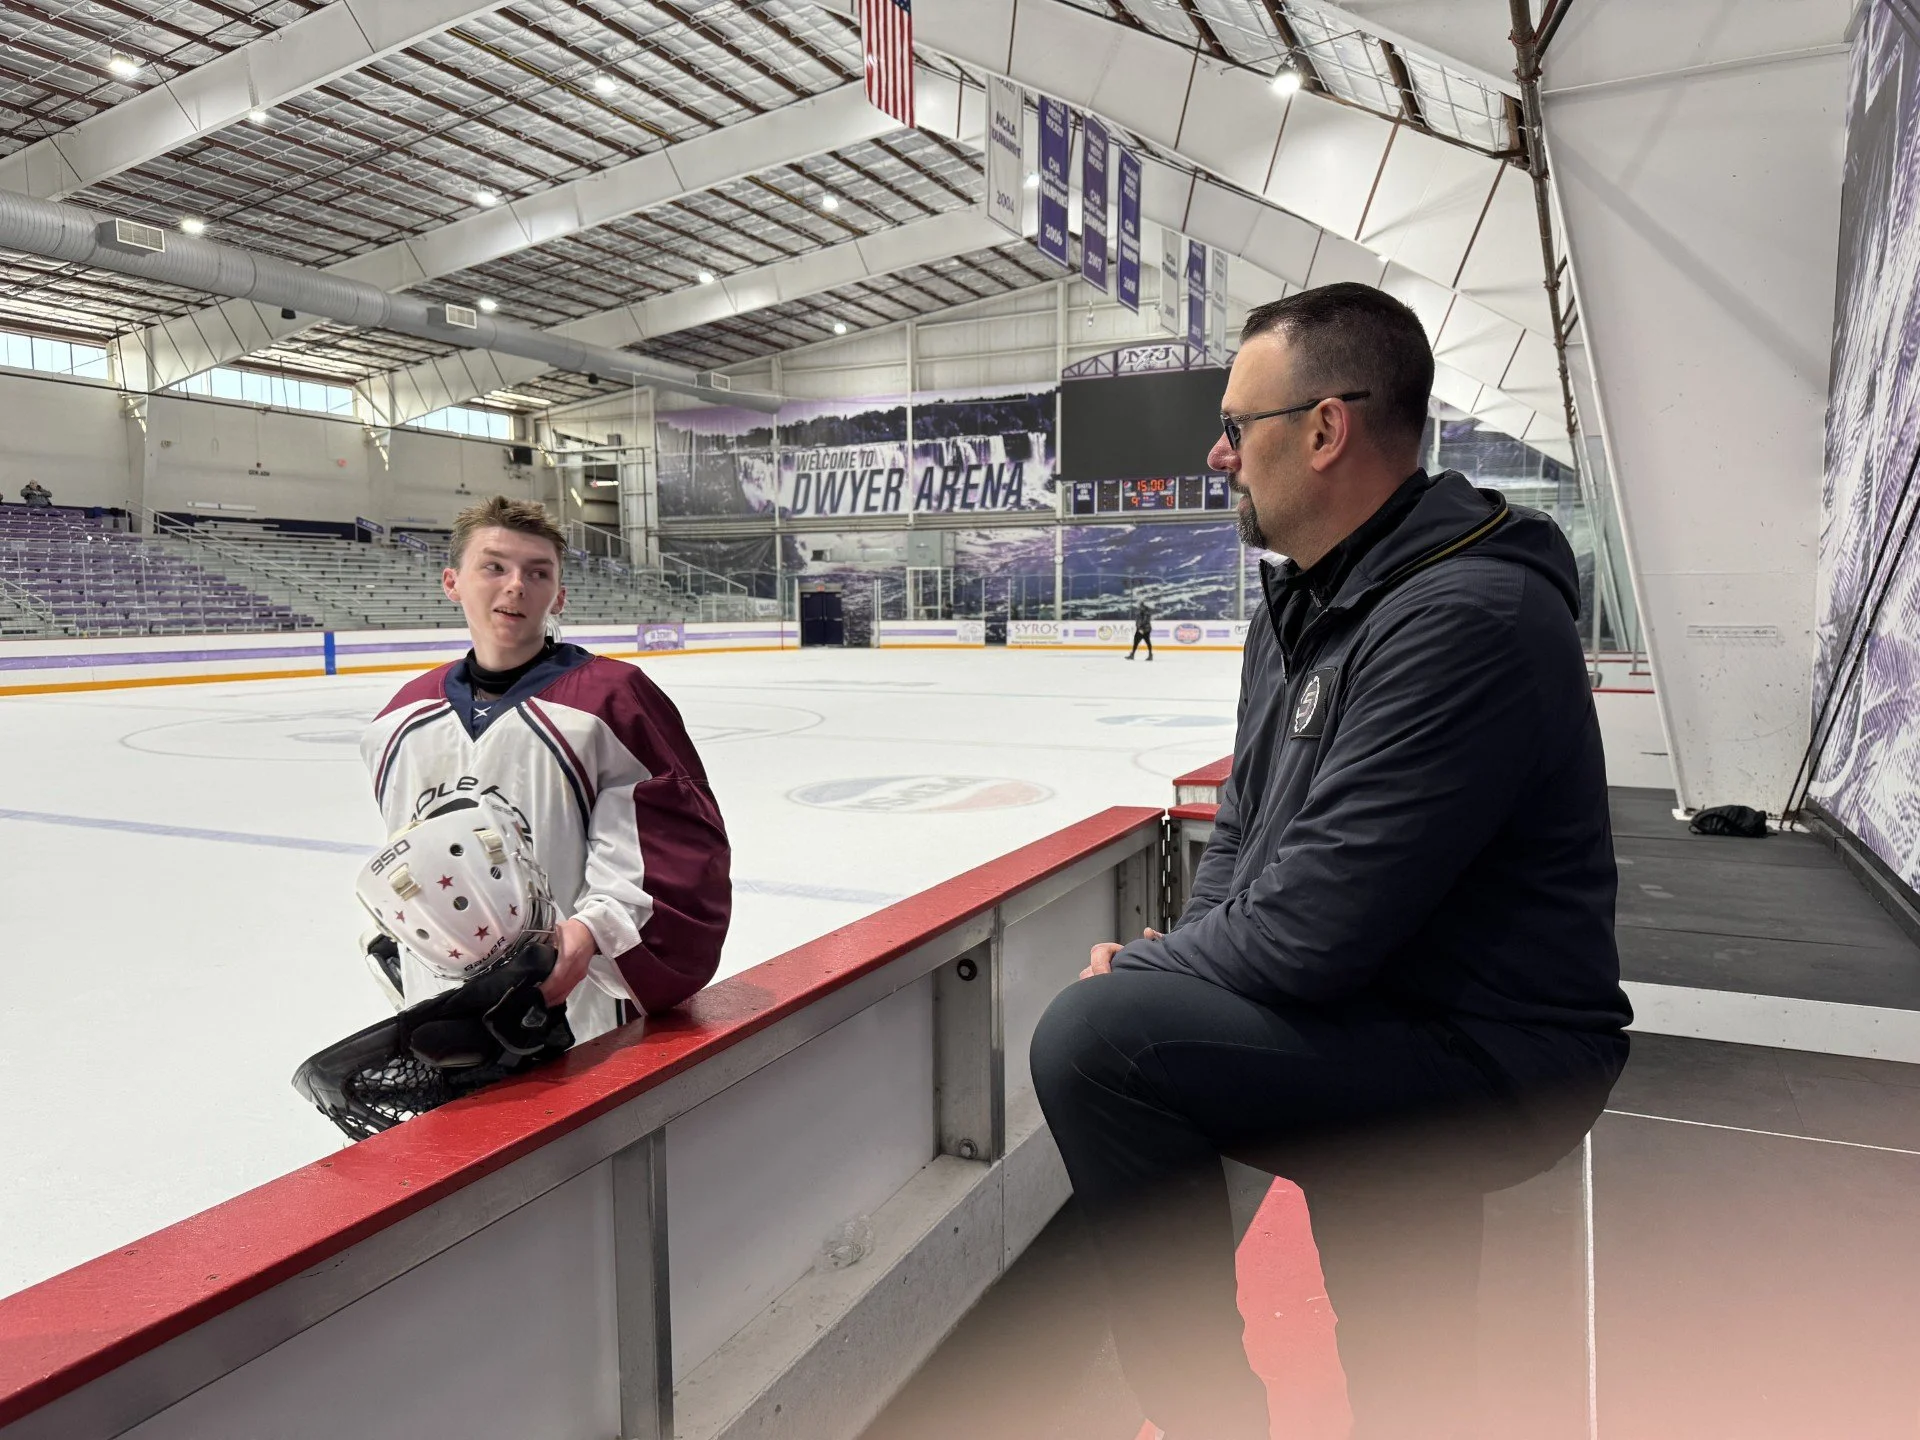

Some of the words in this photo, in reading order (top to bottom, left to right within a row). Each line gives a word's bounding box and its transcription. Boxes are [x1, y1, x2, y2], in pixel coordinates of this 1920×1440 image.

[996, 111, 1016, 139] NCAA
[796, 450, 857, 471] WELCOME
[859, 450, 875, 468] TO
[791, 467, 905, 516] DWYER
[914, 462, 1024, 511] ARENA
[1137, 479, 1164, 492] 15:00
[1015, 623, 1059, 634] SYROS
[371, 839, 411, 876] 950
